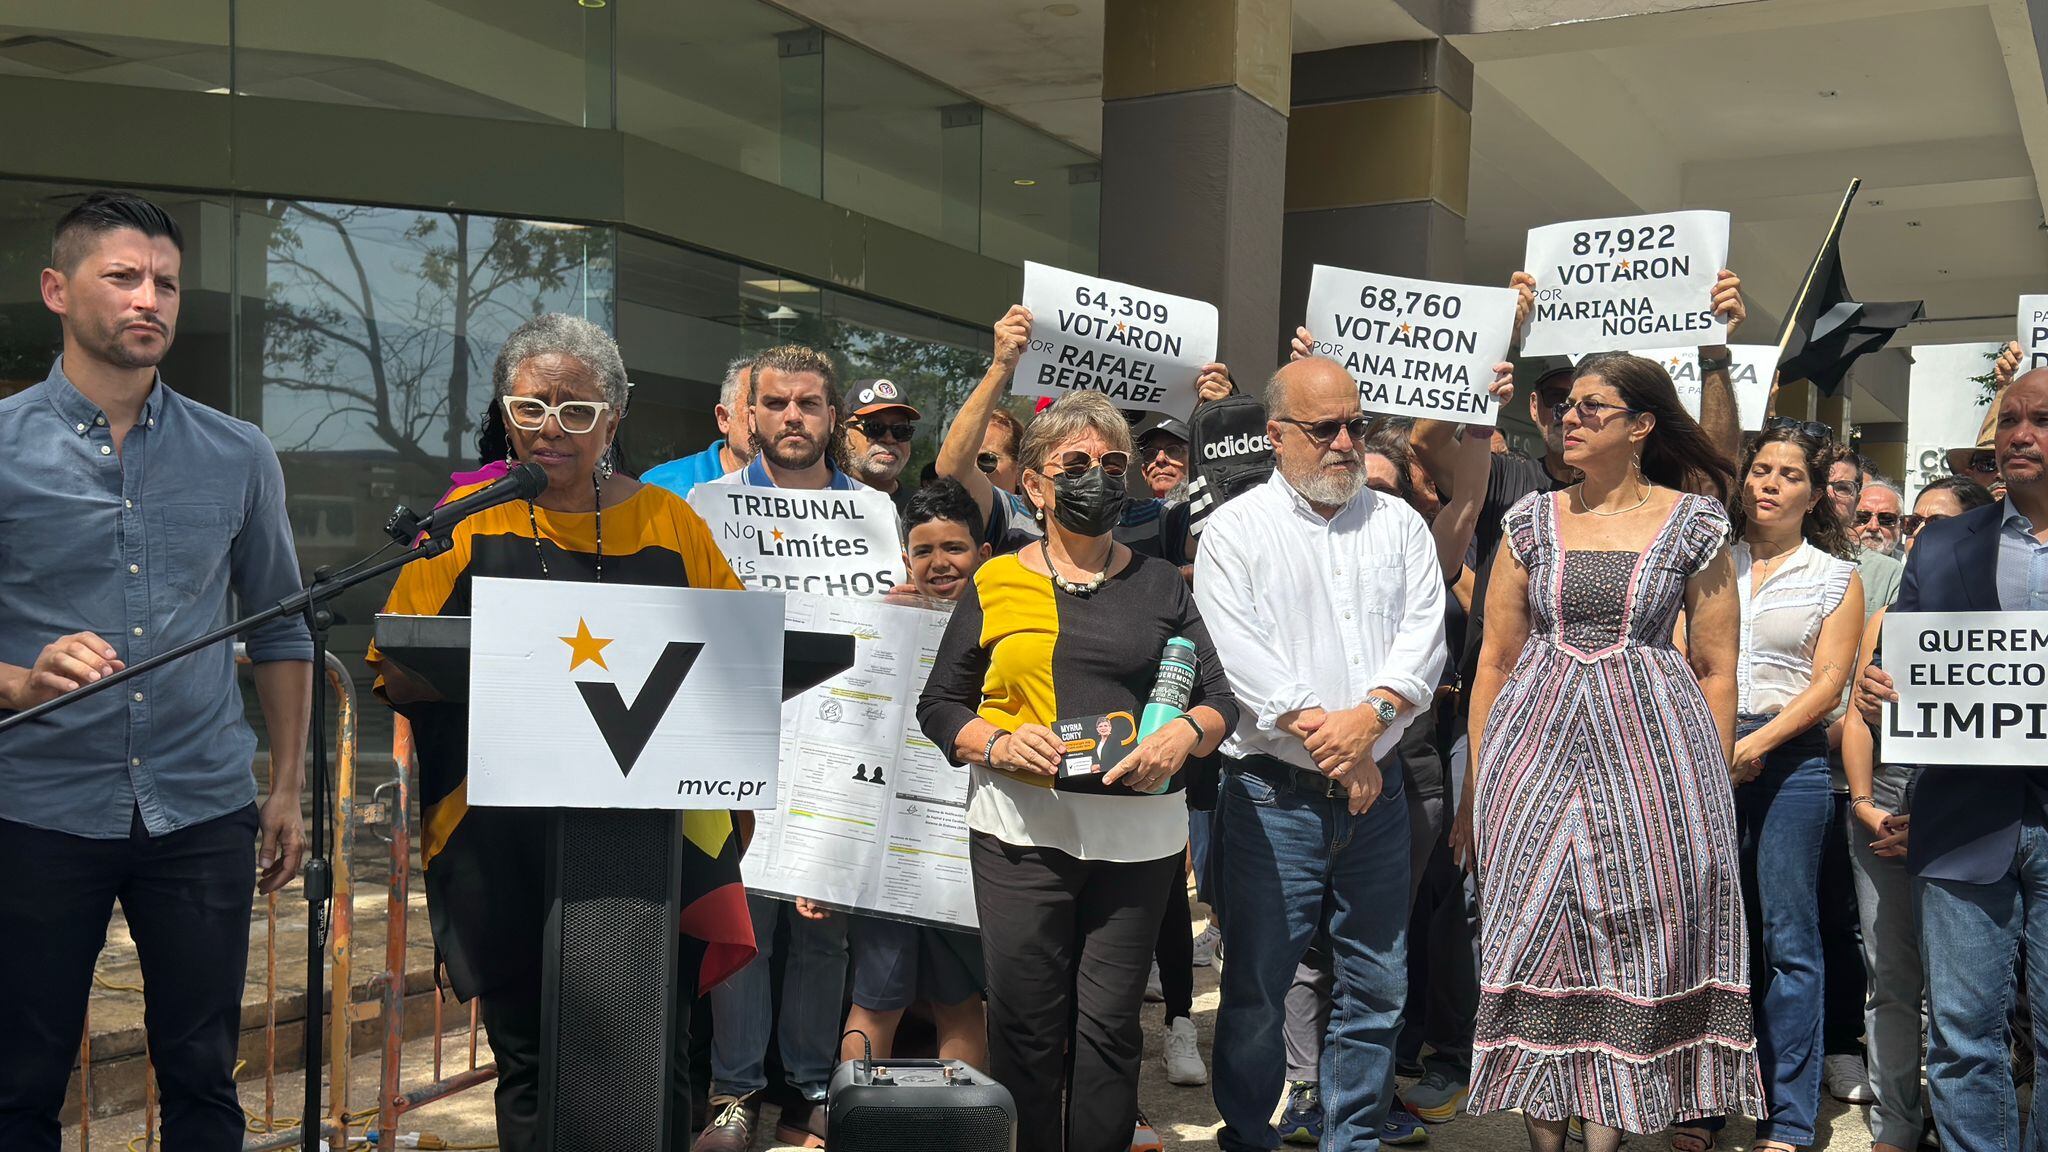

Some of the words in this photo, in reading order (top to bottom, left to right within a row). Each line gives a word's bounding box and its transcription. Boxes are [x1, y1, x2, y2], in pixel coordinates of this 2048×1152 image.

[1572, 224, 1676, 258] 87,922
[1557, 255, 1690, 286] VOTARON
[1075, 286, 1168, 325] 64,309
[1360, 285, 1461, 319] 68,760
[1537, 296, 1654, 322] MARIANA
[1057, 309, 1182, 357] VOTARON
[1334, 314, 1477, 354] VOTARON
[1602, 310, 1712, 337] NOGALES
[1058, 344, 1157, 384] RAFAEL
[1312, 340, 1344, 357] POR
[1344, 351, 1396, 378] ANA
[1402, 359, 1470, 386] IRMA
[1395, 384, 1489, 415] LASSÉN
[1203, 433, 1273, 460] adidas
[727, 494, 865, 520] TRIBUNAL
[724, 521, 755, 540] No
[756, 529, 869, 557] Limítes
[1910, 663, 2045, 686] ELECCIO
[1061, 731, 1082, 742] CONTY
[1890, 702, 2048, 740] LIMPI
[677, 778, 767, 801] mvc.pr
